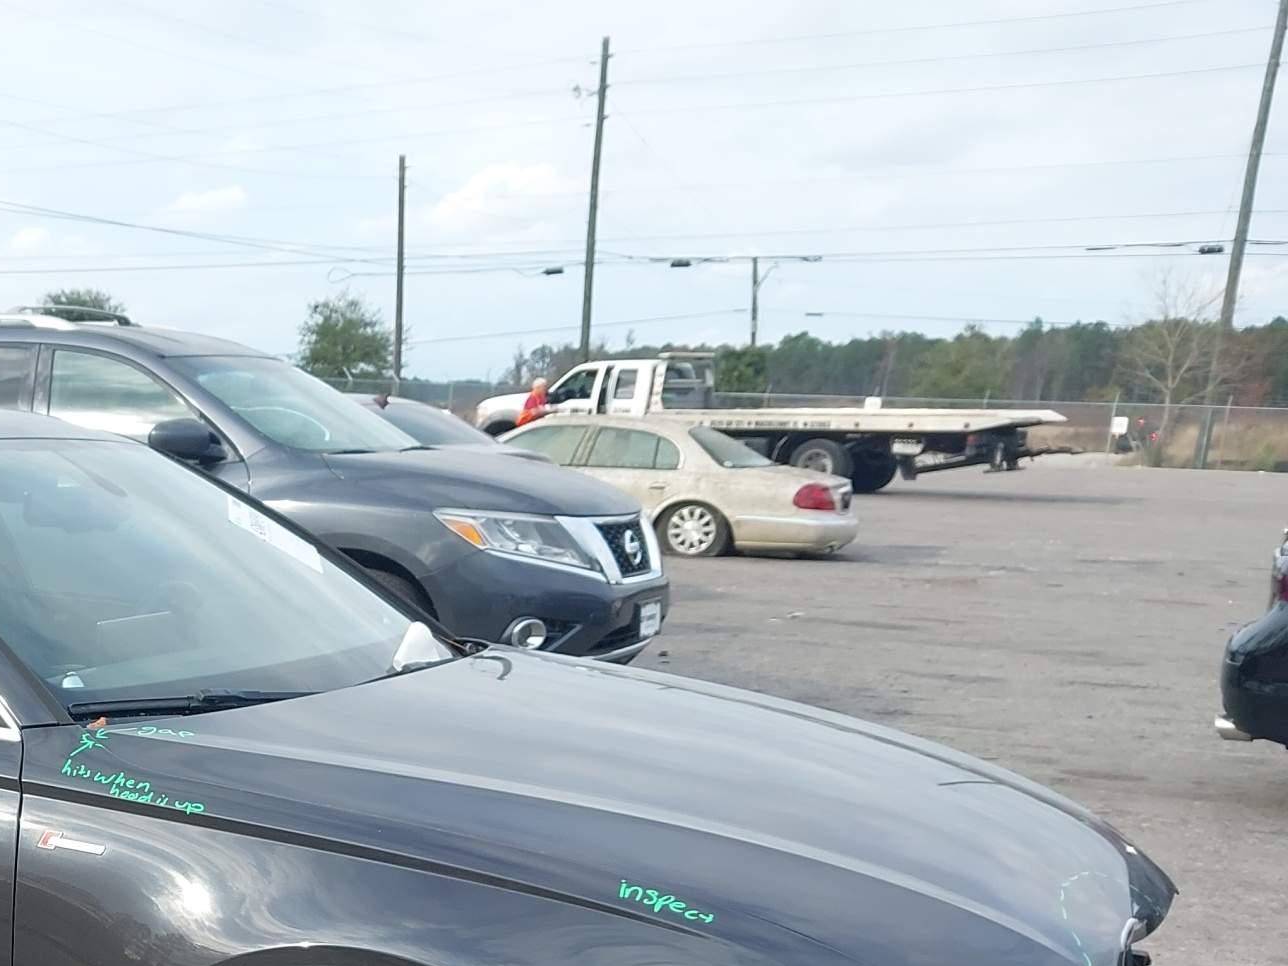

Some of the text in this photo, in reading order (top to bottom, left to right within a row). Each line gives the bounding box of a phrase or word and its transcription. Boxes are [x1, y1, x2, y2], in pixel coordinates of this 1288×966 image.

[94, 771, 151, 793] when
[175, 800, 205, 815] up
[618, 879, 715, 924] inspect
